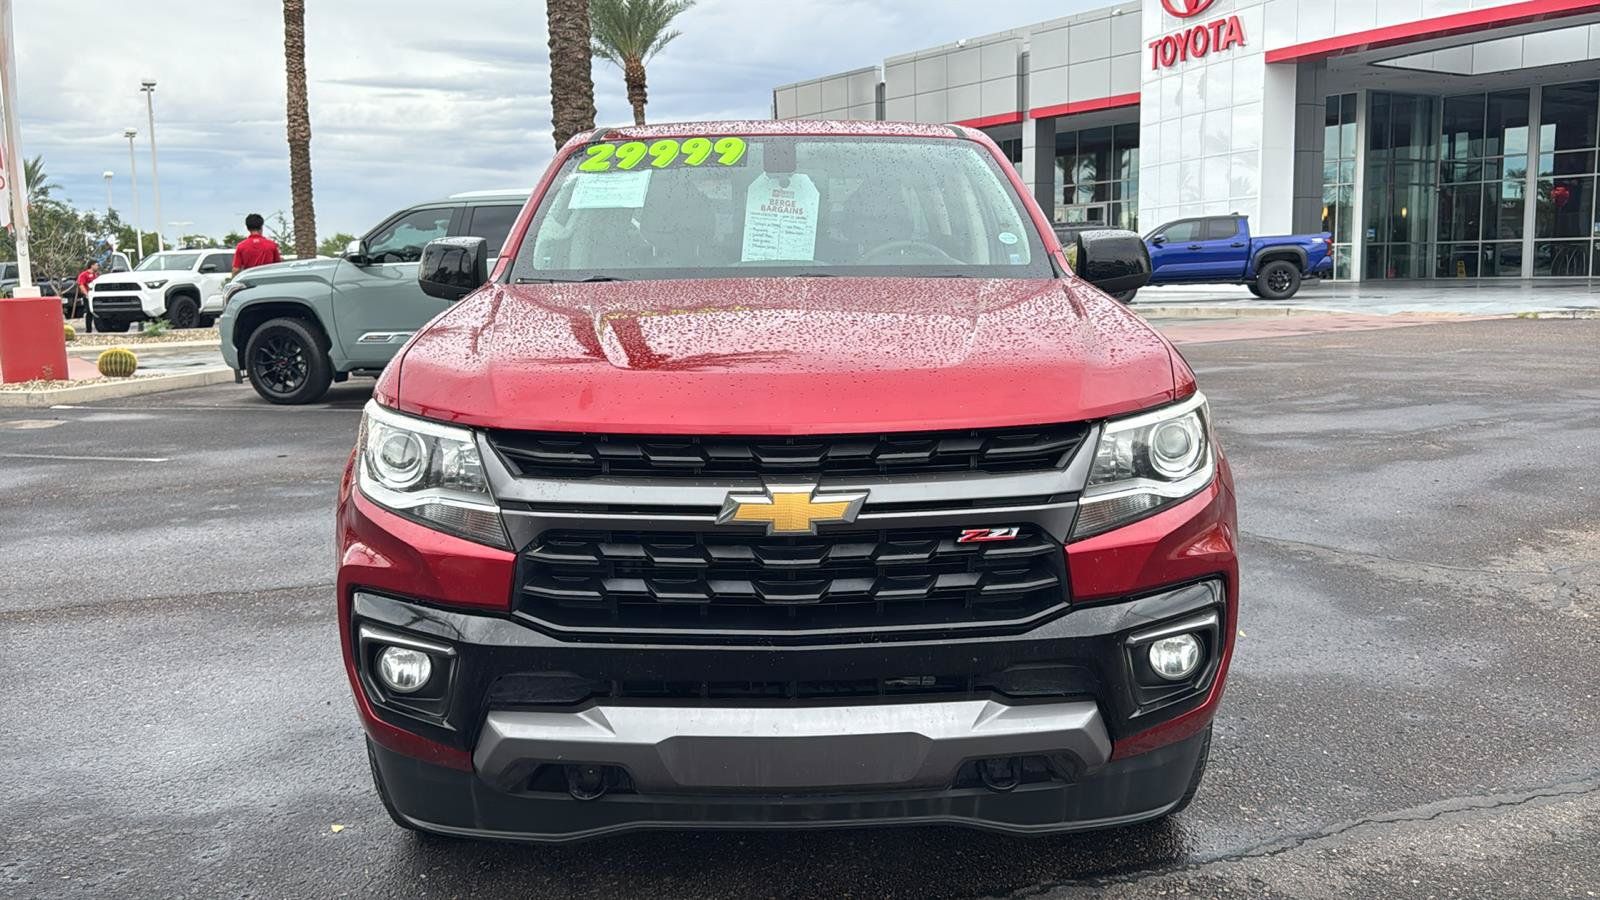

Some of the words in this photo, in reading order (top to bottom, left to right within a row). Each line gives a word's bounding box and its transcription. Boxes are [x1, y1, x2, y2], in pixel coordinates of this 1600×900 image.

[1148, 15, 1246, 71] TOYOTA
[578, 137, 747, 172] 29999
[760, 205, 804, 216] BARGAINS
[769, 199, 797, 208] BERGE
[956, 527, 1020, 543] Z71
